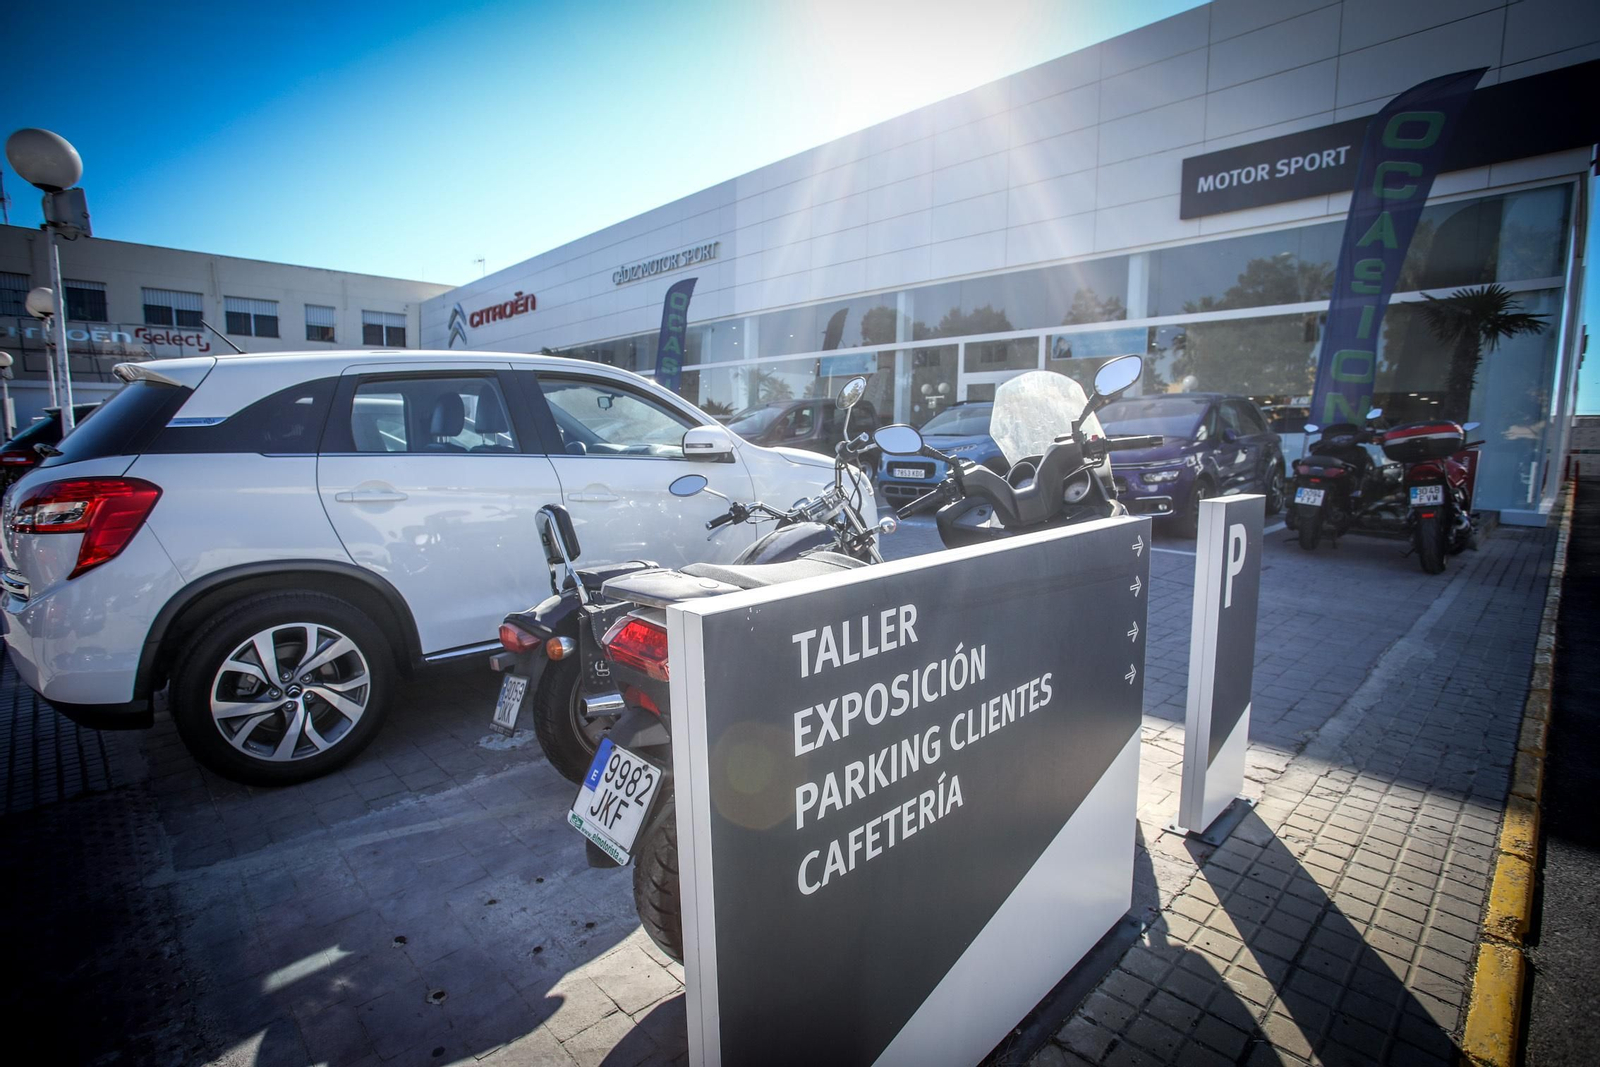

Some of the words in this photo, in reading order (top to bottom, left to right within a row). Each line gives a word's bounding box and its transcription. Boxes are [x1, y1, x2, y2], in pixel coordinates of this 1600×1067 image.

[1197, 163, 1270, 193] MOTOR
[1275, 145, 1351, 178] SPORT
[641, 253, 680, 277] MOTOR
[680, 241, 720, 268] SPORT
[1322, 111, 1446, 425] OCASION
[142, 331, 203, 347] select
[1224, 523, 1247, 609] P
[792, 603, 919, 679] TALLER
[793, 641, 986, 757] EXPOSICIÓN
[590, 769, 599, 781] E
[604, 753, 654, 807] 9982
[795, 725, 941, 831] PARKING
[950, 672, 1053, 751] CLIENTES
[590, 788, 630, 830] JKF
[797, 771, 964, 896] CAFETERÍA
